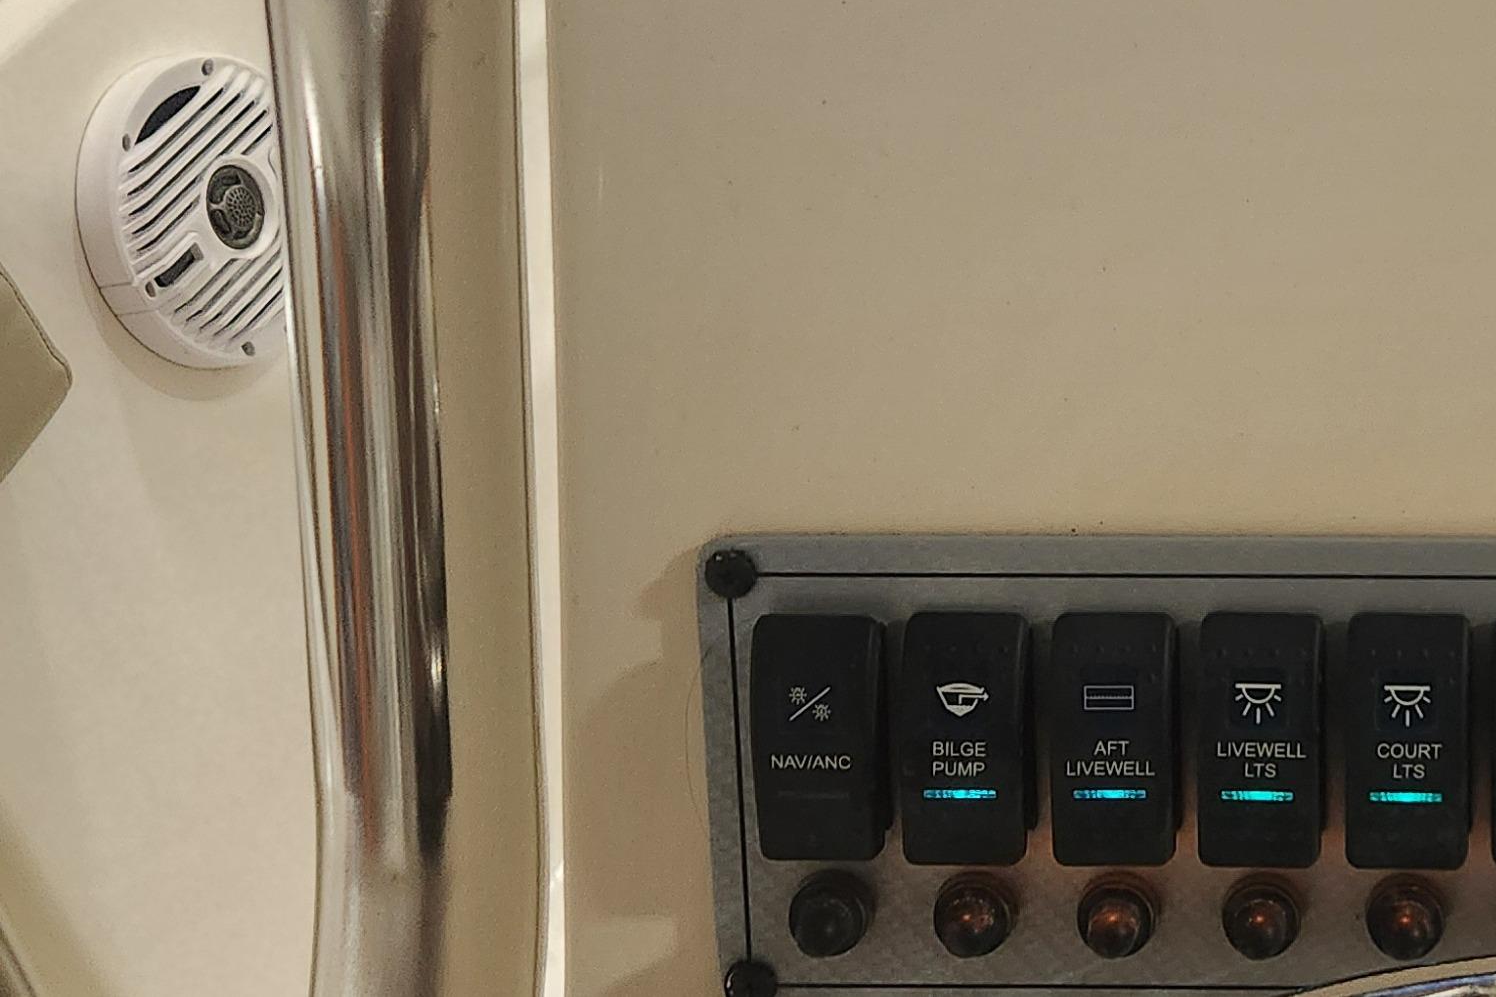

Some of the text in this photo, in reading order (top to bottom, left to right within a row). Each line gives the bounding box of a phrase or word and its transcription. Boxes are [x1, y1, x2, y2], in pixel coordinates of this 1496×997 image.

[933, 741, 986, 757] BILGE
[1094, 740, 1129, 756] AFT
[1217, 742, 1307, 758] LIVEWELL
[1377, 743, 1442, 759] COURT
[771, 755, 851, 770] NAV/ANC
[933, 762, 985, 777] PUMP
[1066, 761, 1155, 777] LIVEWELL
[1245, 763, 1276, 778] LTS
[1393, 764, 1425, 779] LTS
